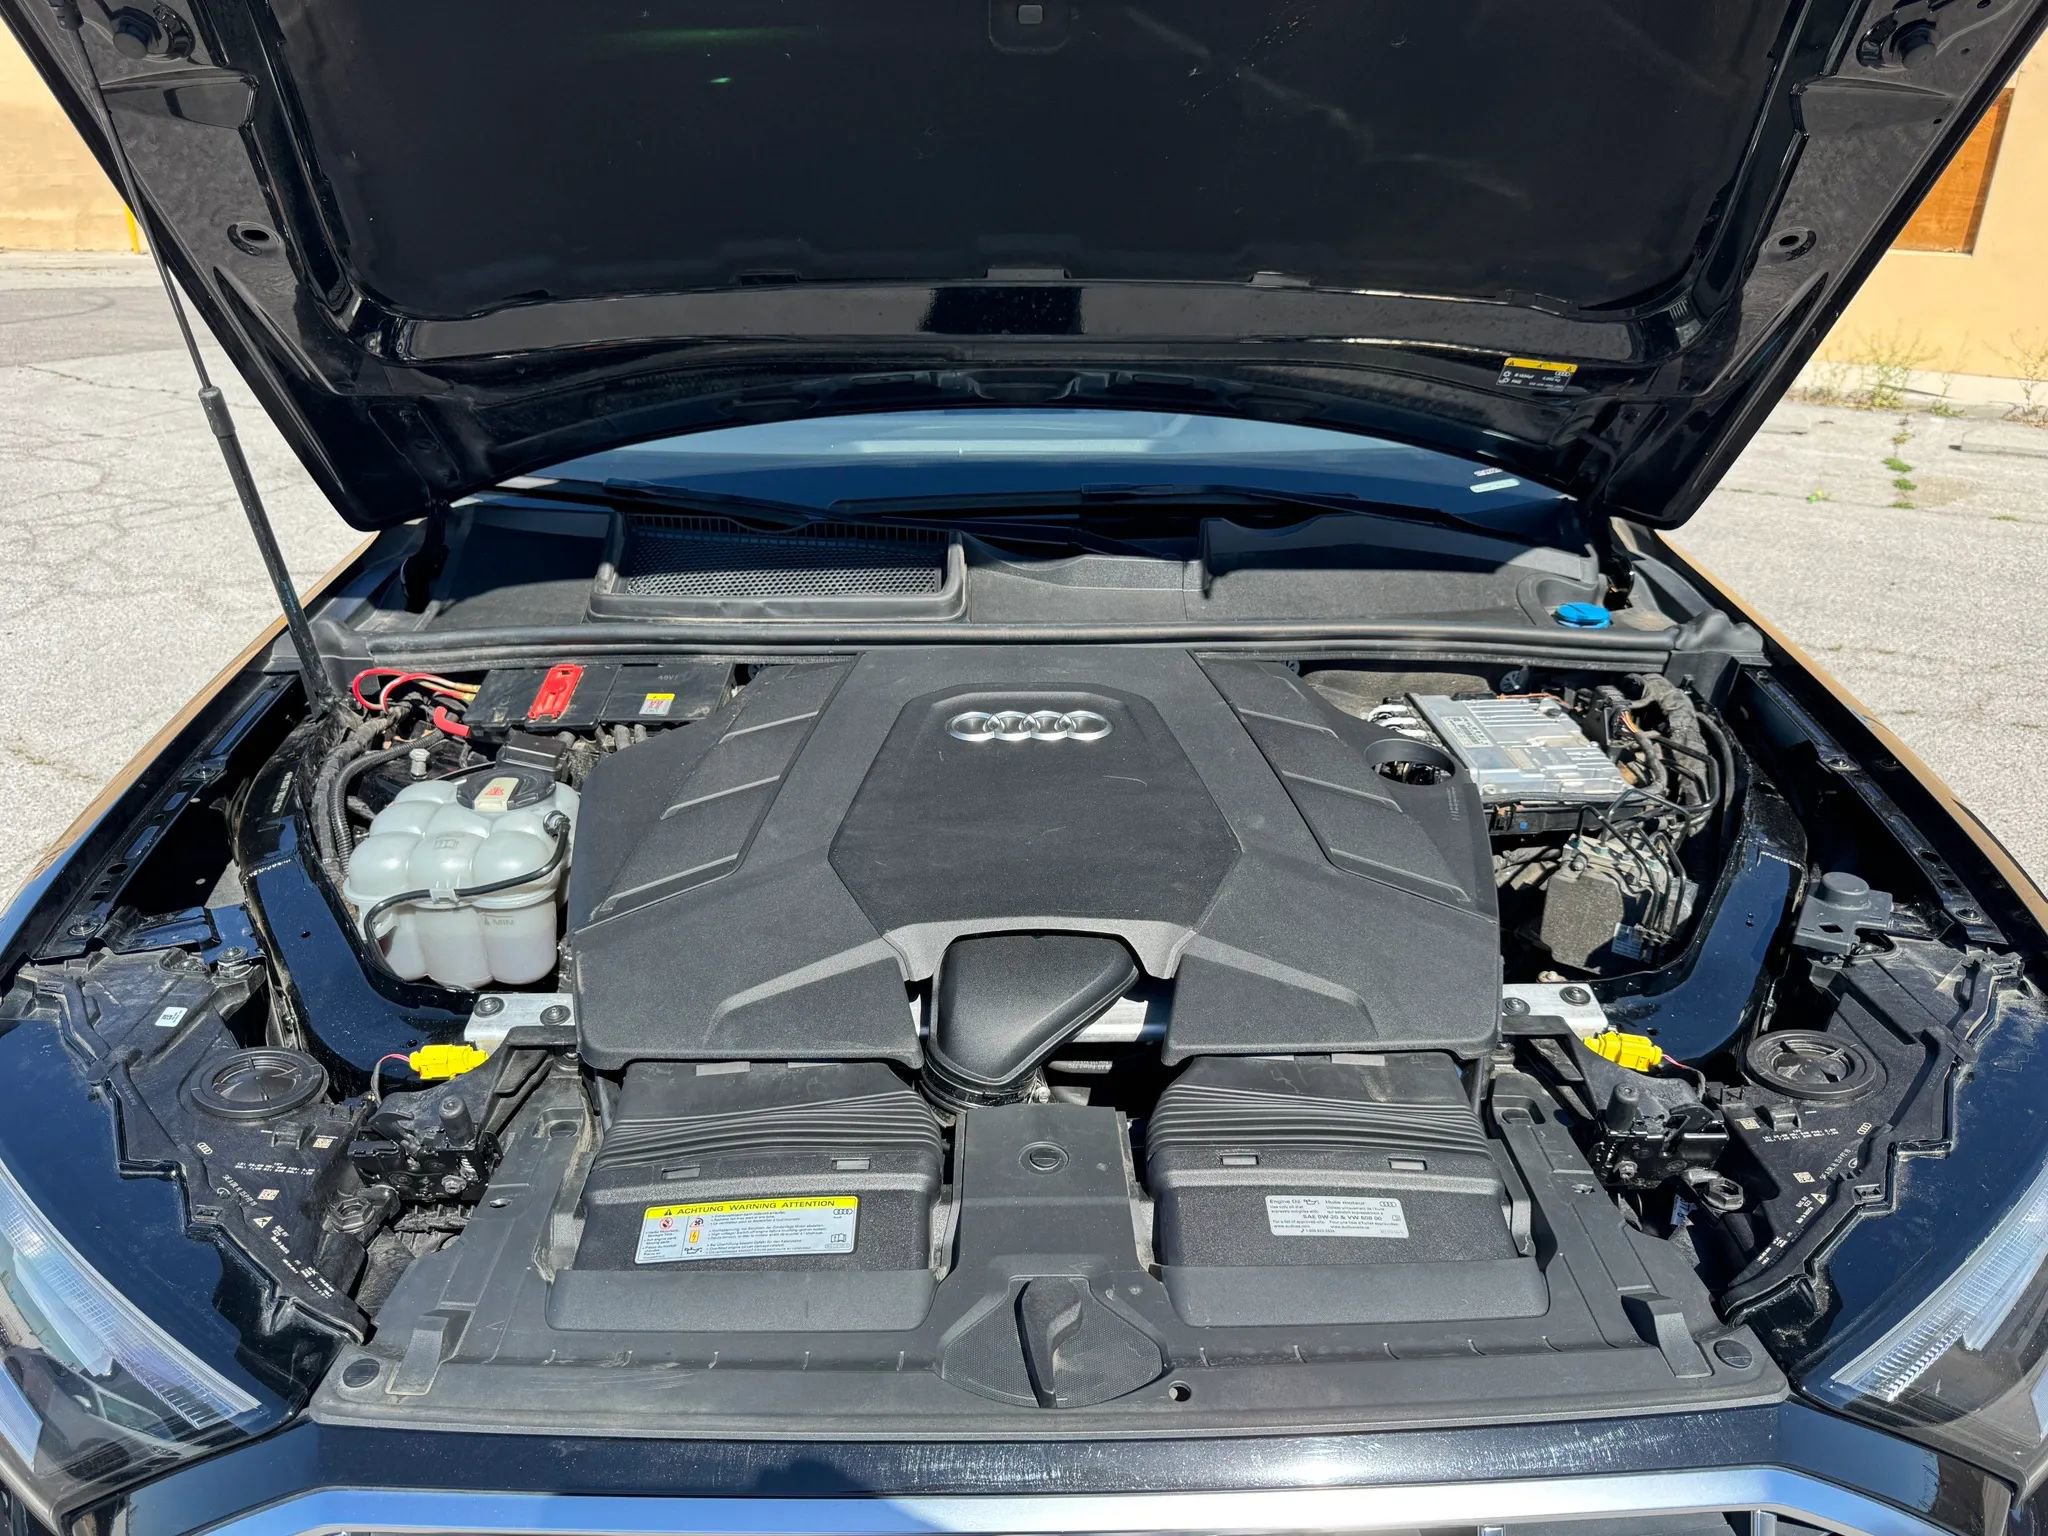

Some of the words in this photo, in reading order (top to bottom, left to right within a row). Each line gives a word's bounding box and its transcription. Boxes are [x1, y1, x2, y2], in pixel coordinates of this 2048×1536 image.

[676, 1205, 724, 1215] ACHTUNG
[729, 1202, 777, 1211] WARNING
[781, 1200, 835, 1208] ATTENTION
